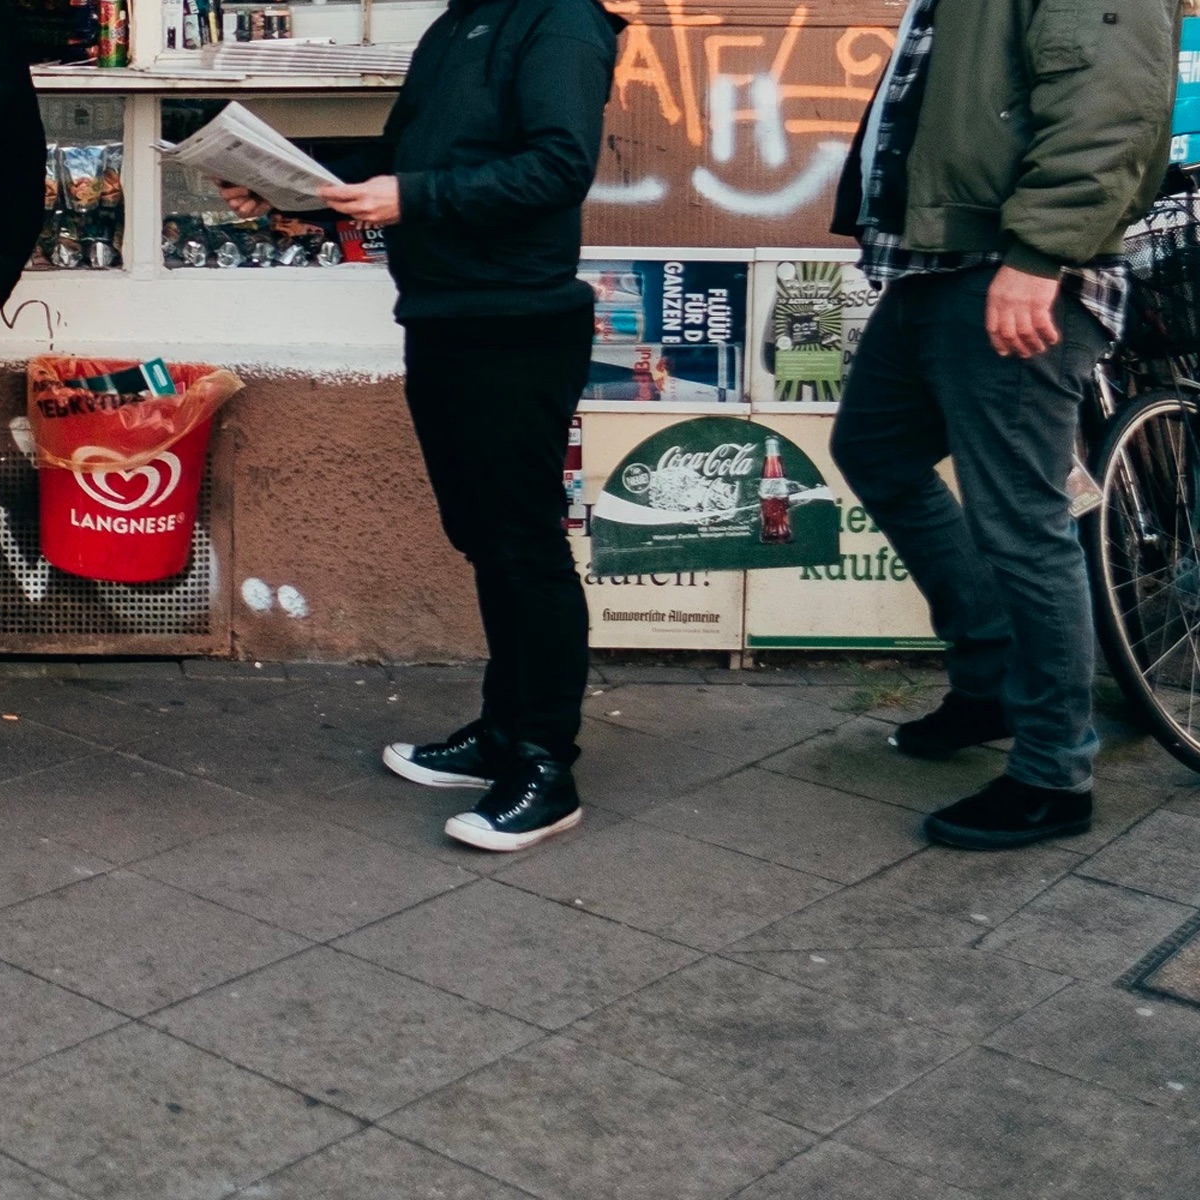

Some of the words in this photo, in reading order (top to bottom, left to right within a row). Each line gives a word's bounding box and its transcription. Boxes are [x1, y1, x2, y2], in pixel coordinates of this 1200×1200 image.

[662, 262, 685, 331] GANZEN
[684, 293, 708, 325] FÜR
[656, 443, 758, 477] Coca-Cola
[70, 509, 178, 535] LANGNESE
[668, 609, 721, 625] Allgemeine
